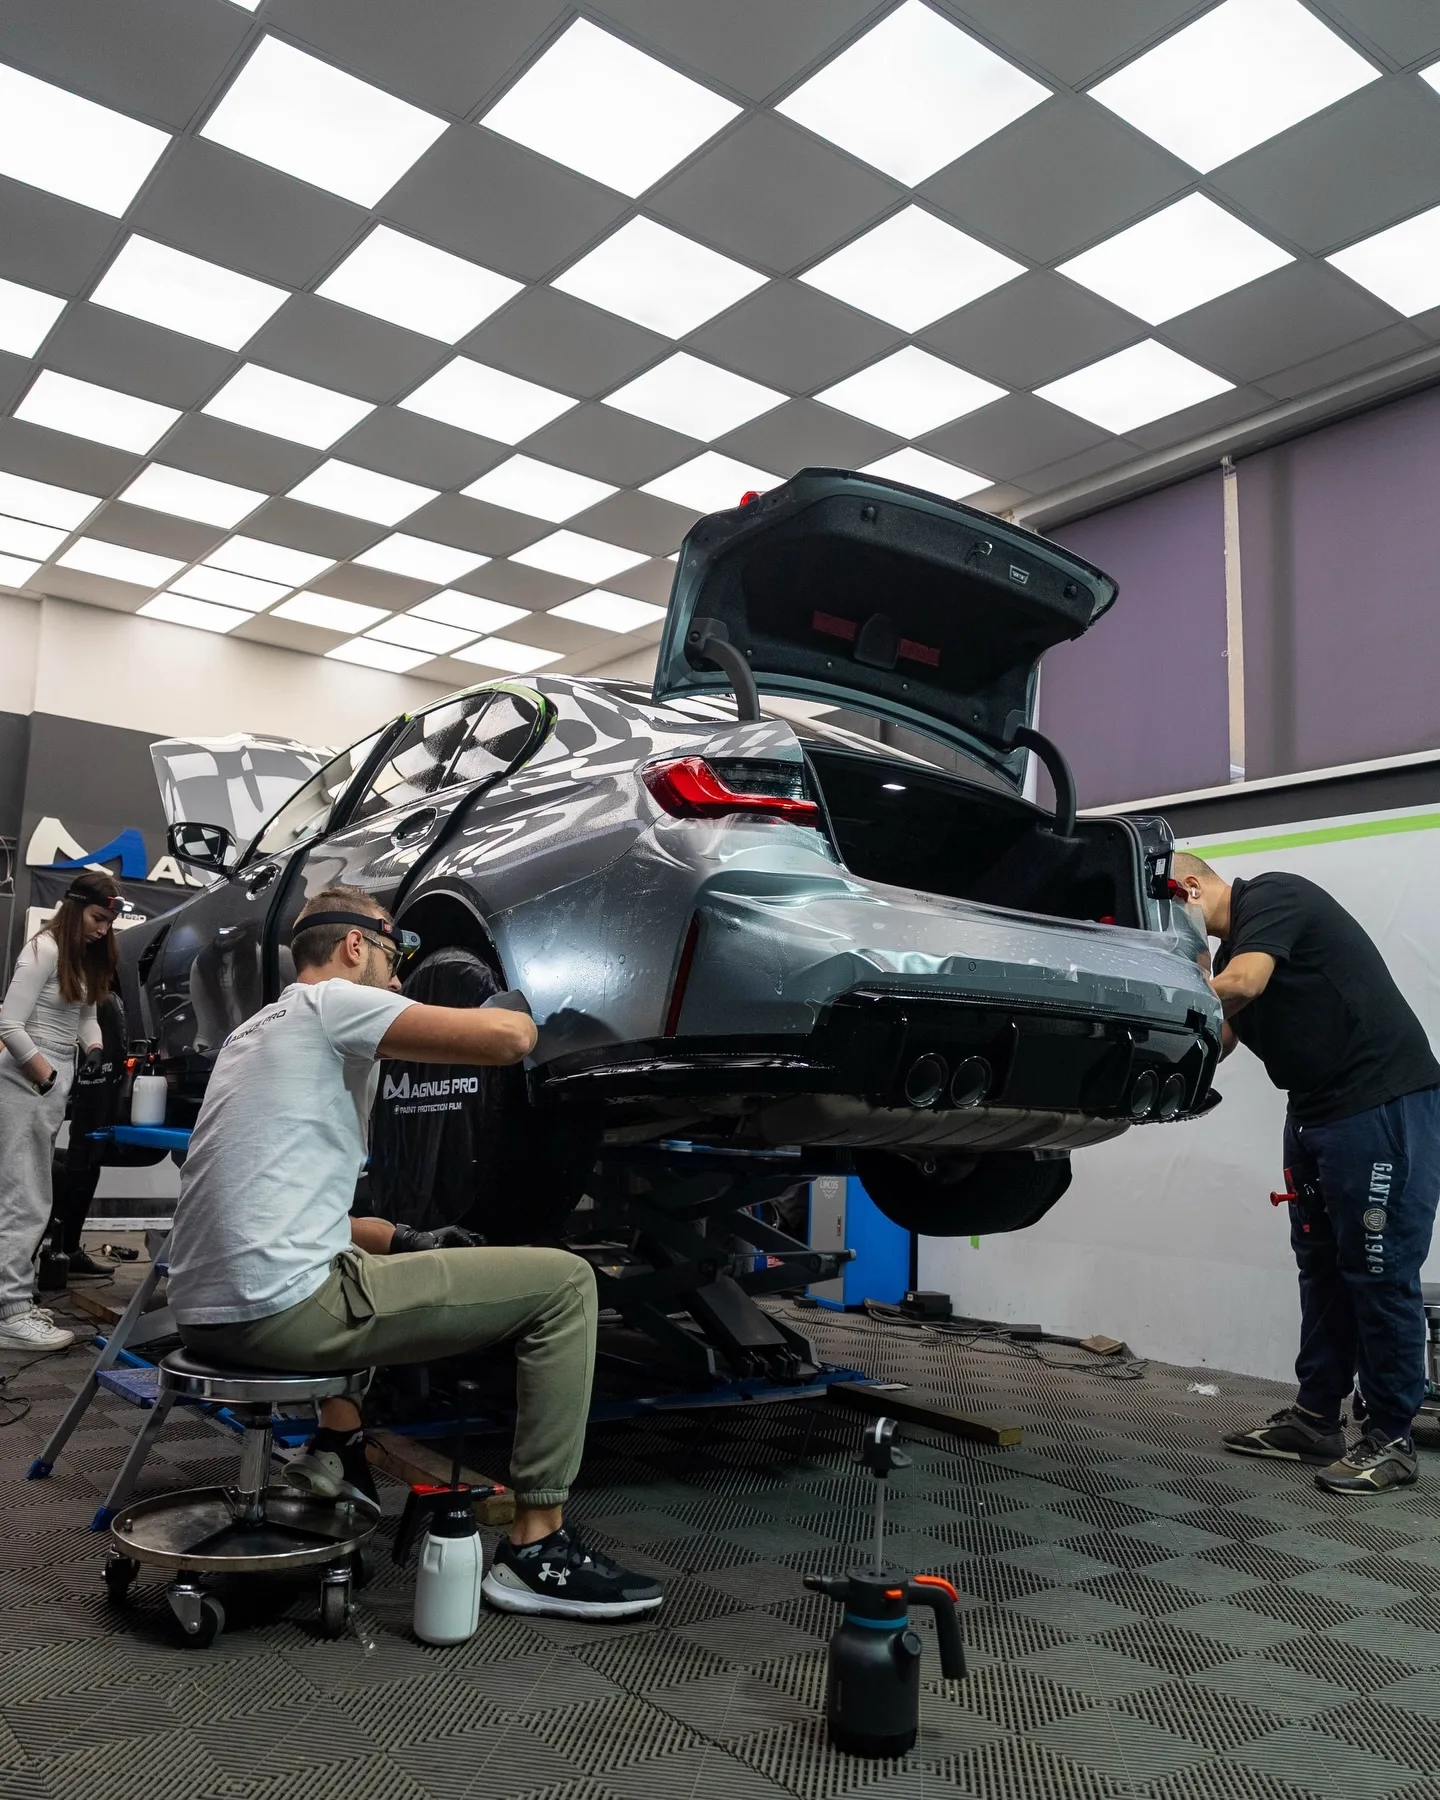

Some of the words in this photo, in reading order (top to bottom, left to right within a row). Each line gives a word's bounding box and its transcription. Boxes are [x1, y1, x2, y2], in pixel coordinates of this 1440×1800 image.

[262, 1009, 287, 1026] PRO
[383, 1072, 450, 1100] MAGNUS
[451, 1077, 478, 1094] PRO
[400, 1106, 416, 1114] PAINT
[417, 1103, 448, 1113] PROTECTION
[448, 1102, 462, 1111] FILM
[819, 1179, 839, 1190] LINCOS
[1368, 1162, 1393, 1206] GANT
[1364, 1232, 1384, 1274] 1949
